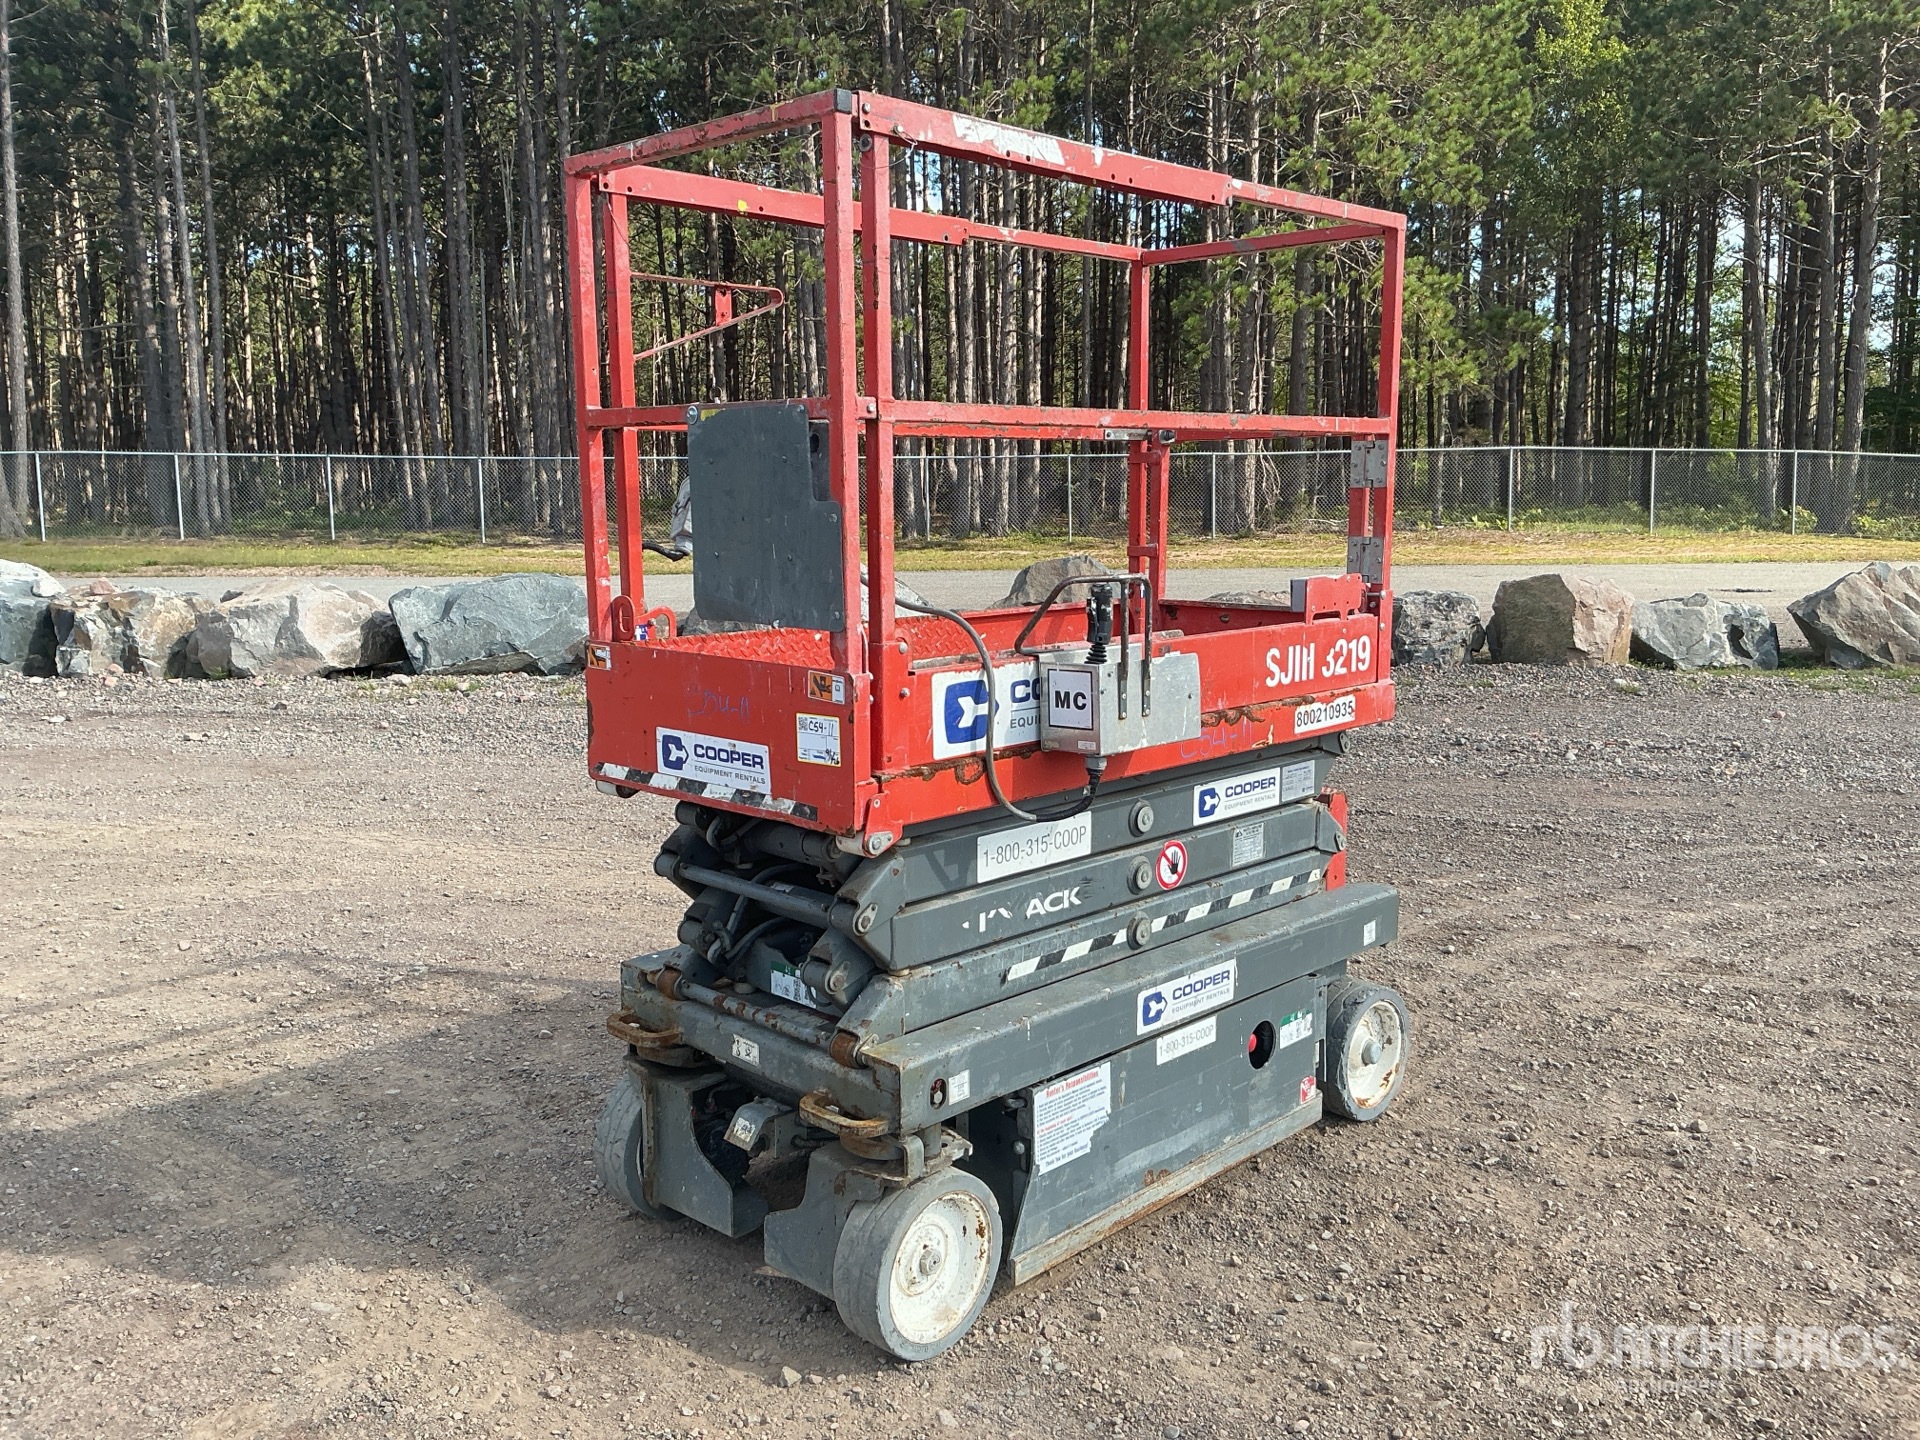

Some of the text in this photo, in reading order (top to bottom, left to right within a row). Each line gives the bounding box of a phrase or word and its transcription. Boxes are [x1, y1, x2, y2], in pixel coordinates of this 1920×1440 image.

[1321, 635, 1371, 678] 3219
[1054, 690, 1087, 711] MC
[1295, 699, 1354, 728] 800210935
[1010, 713, 1041, 729] EQUI
[693, 743, 765, 770] COOPER
[694, 765, 766, 785] EQUIPMENT RENTALS
[1224, 776, 1277, 799] COOPER
[1224, 792, 1276, 811] EQUIPMENT RENTALS
[983, 825, 1087, 868] 1-800-315-COOP
[1171, 969, 1231, 1001] COOPER
[1171, 987, 1231, 1014] EQUIPMENT RENTALS
[1159, 1024, 1214, 1056] 1-800-315-COOP
